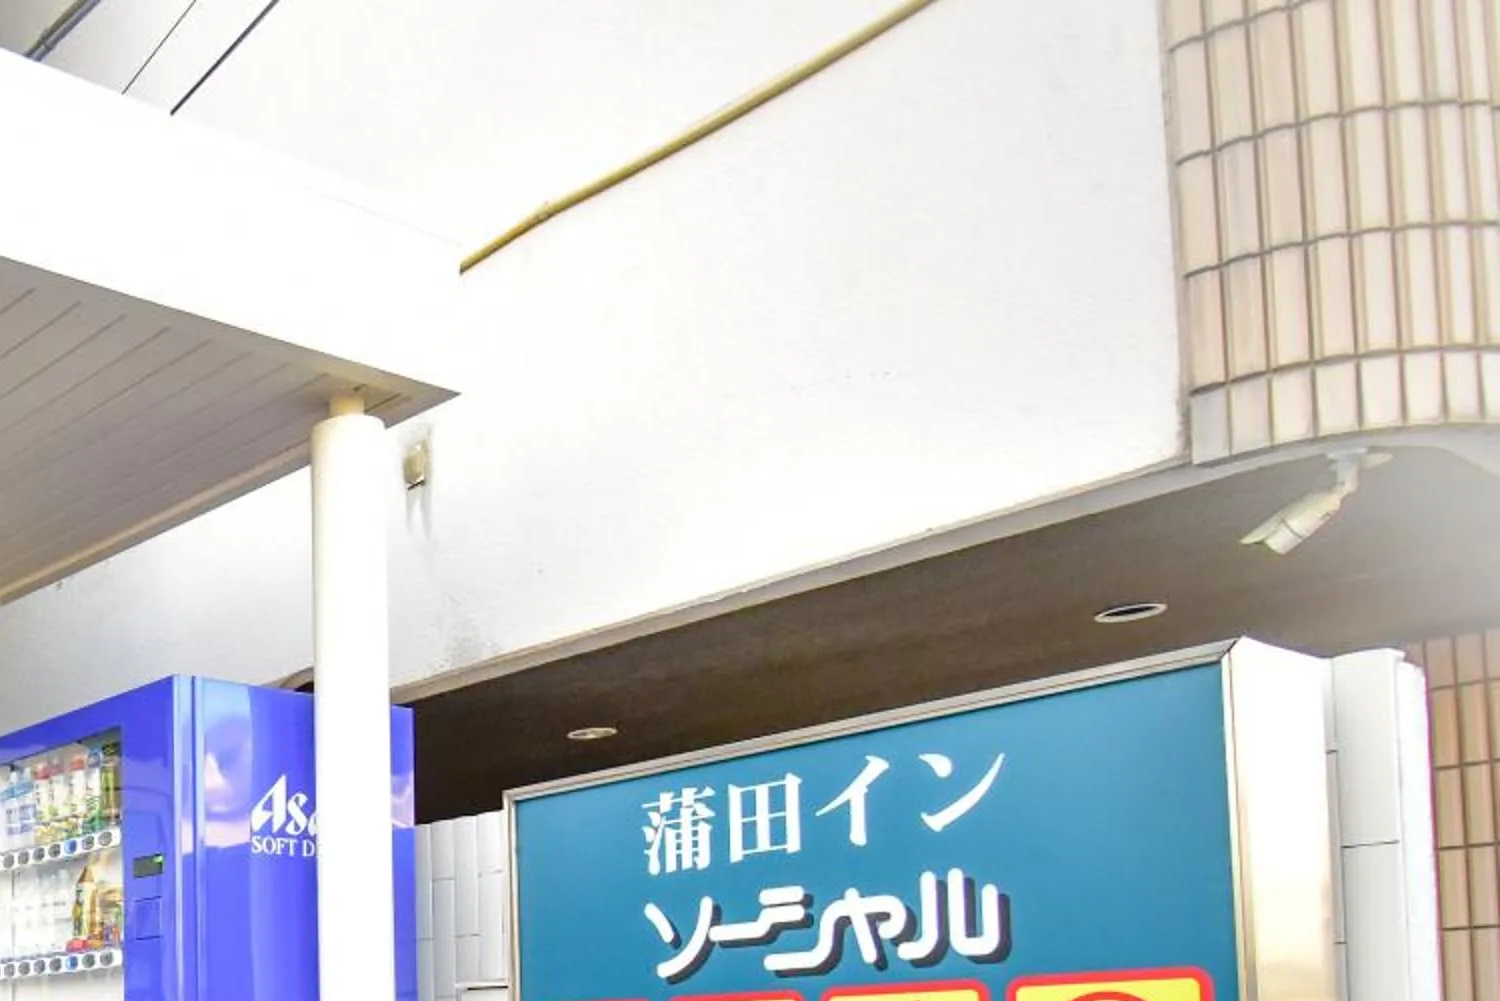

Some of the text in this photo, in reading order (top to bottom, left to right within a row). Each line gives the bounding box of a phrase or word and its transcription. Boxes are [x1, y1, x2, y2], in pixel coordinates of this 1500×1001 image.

[251, 835, 297, 857] SOFT
[641, 753, 1005, 876] 蒲田イン
[643, 867, 1008, 982] ソーシャル
